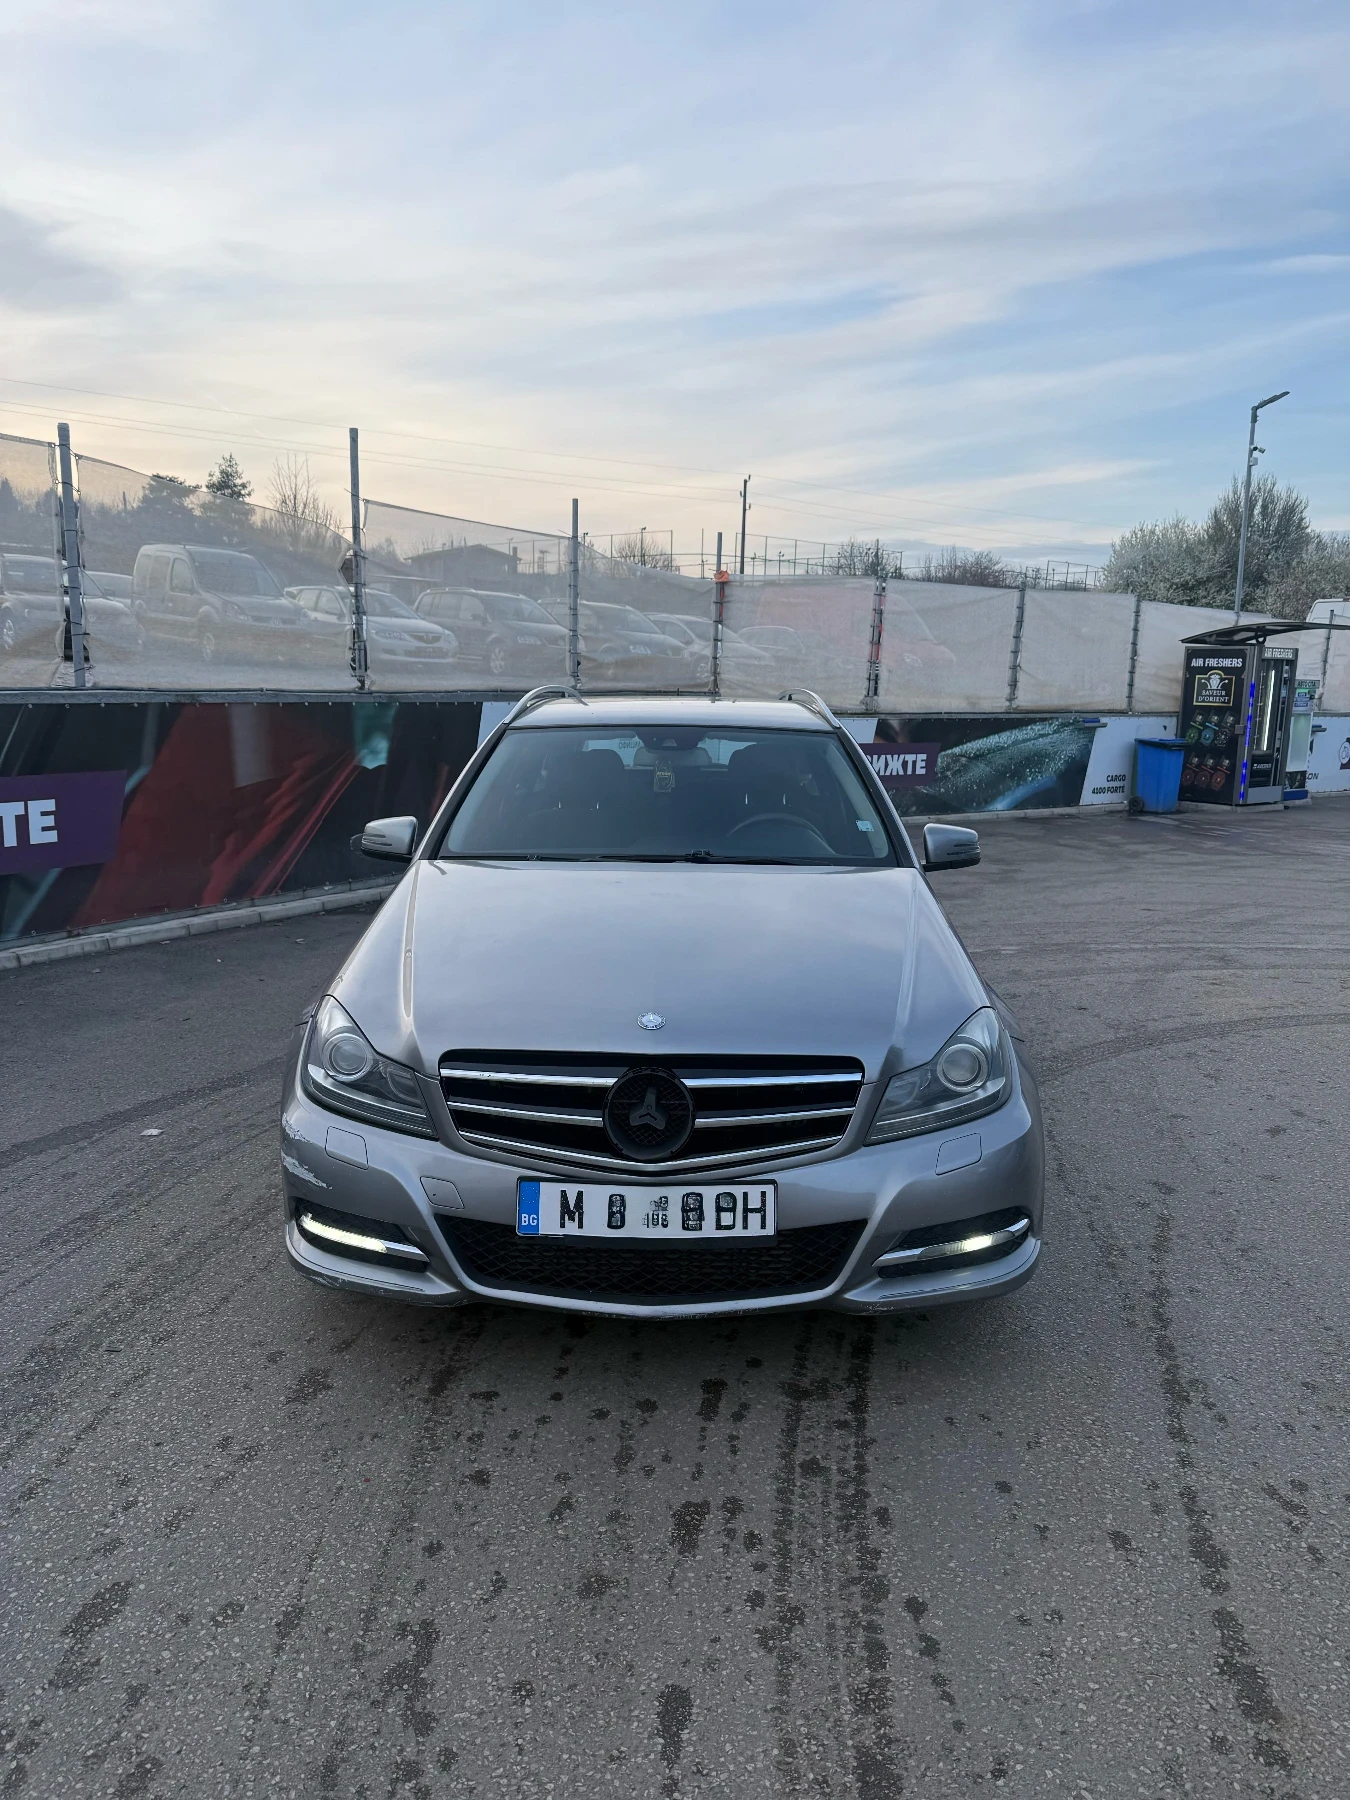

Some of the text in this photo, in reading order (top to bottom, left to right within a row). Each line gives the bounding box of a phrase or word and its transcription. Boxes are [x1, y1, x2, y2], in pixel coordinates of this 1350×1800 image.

[1191, 658, 1243, 667] AIR FRESHERS
[866, 753, 928, 776] ИЖТЕ
[1106, 774, 1126, 782] CARGO
[1092, 786, 1106, 794] 4100
[521, 1213, 538, 1226] BG
